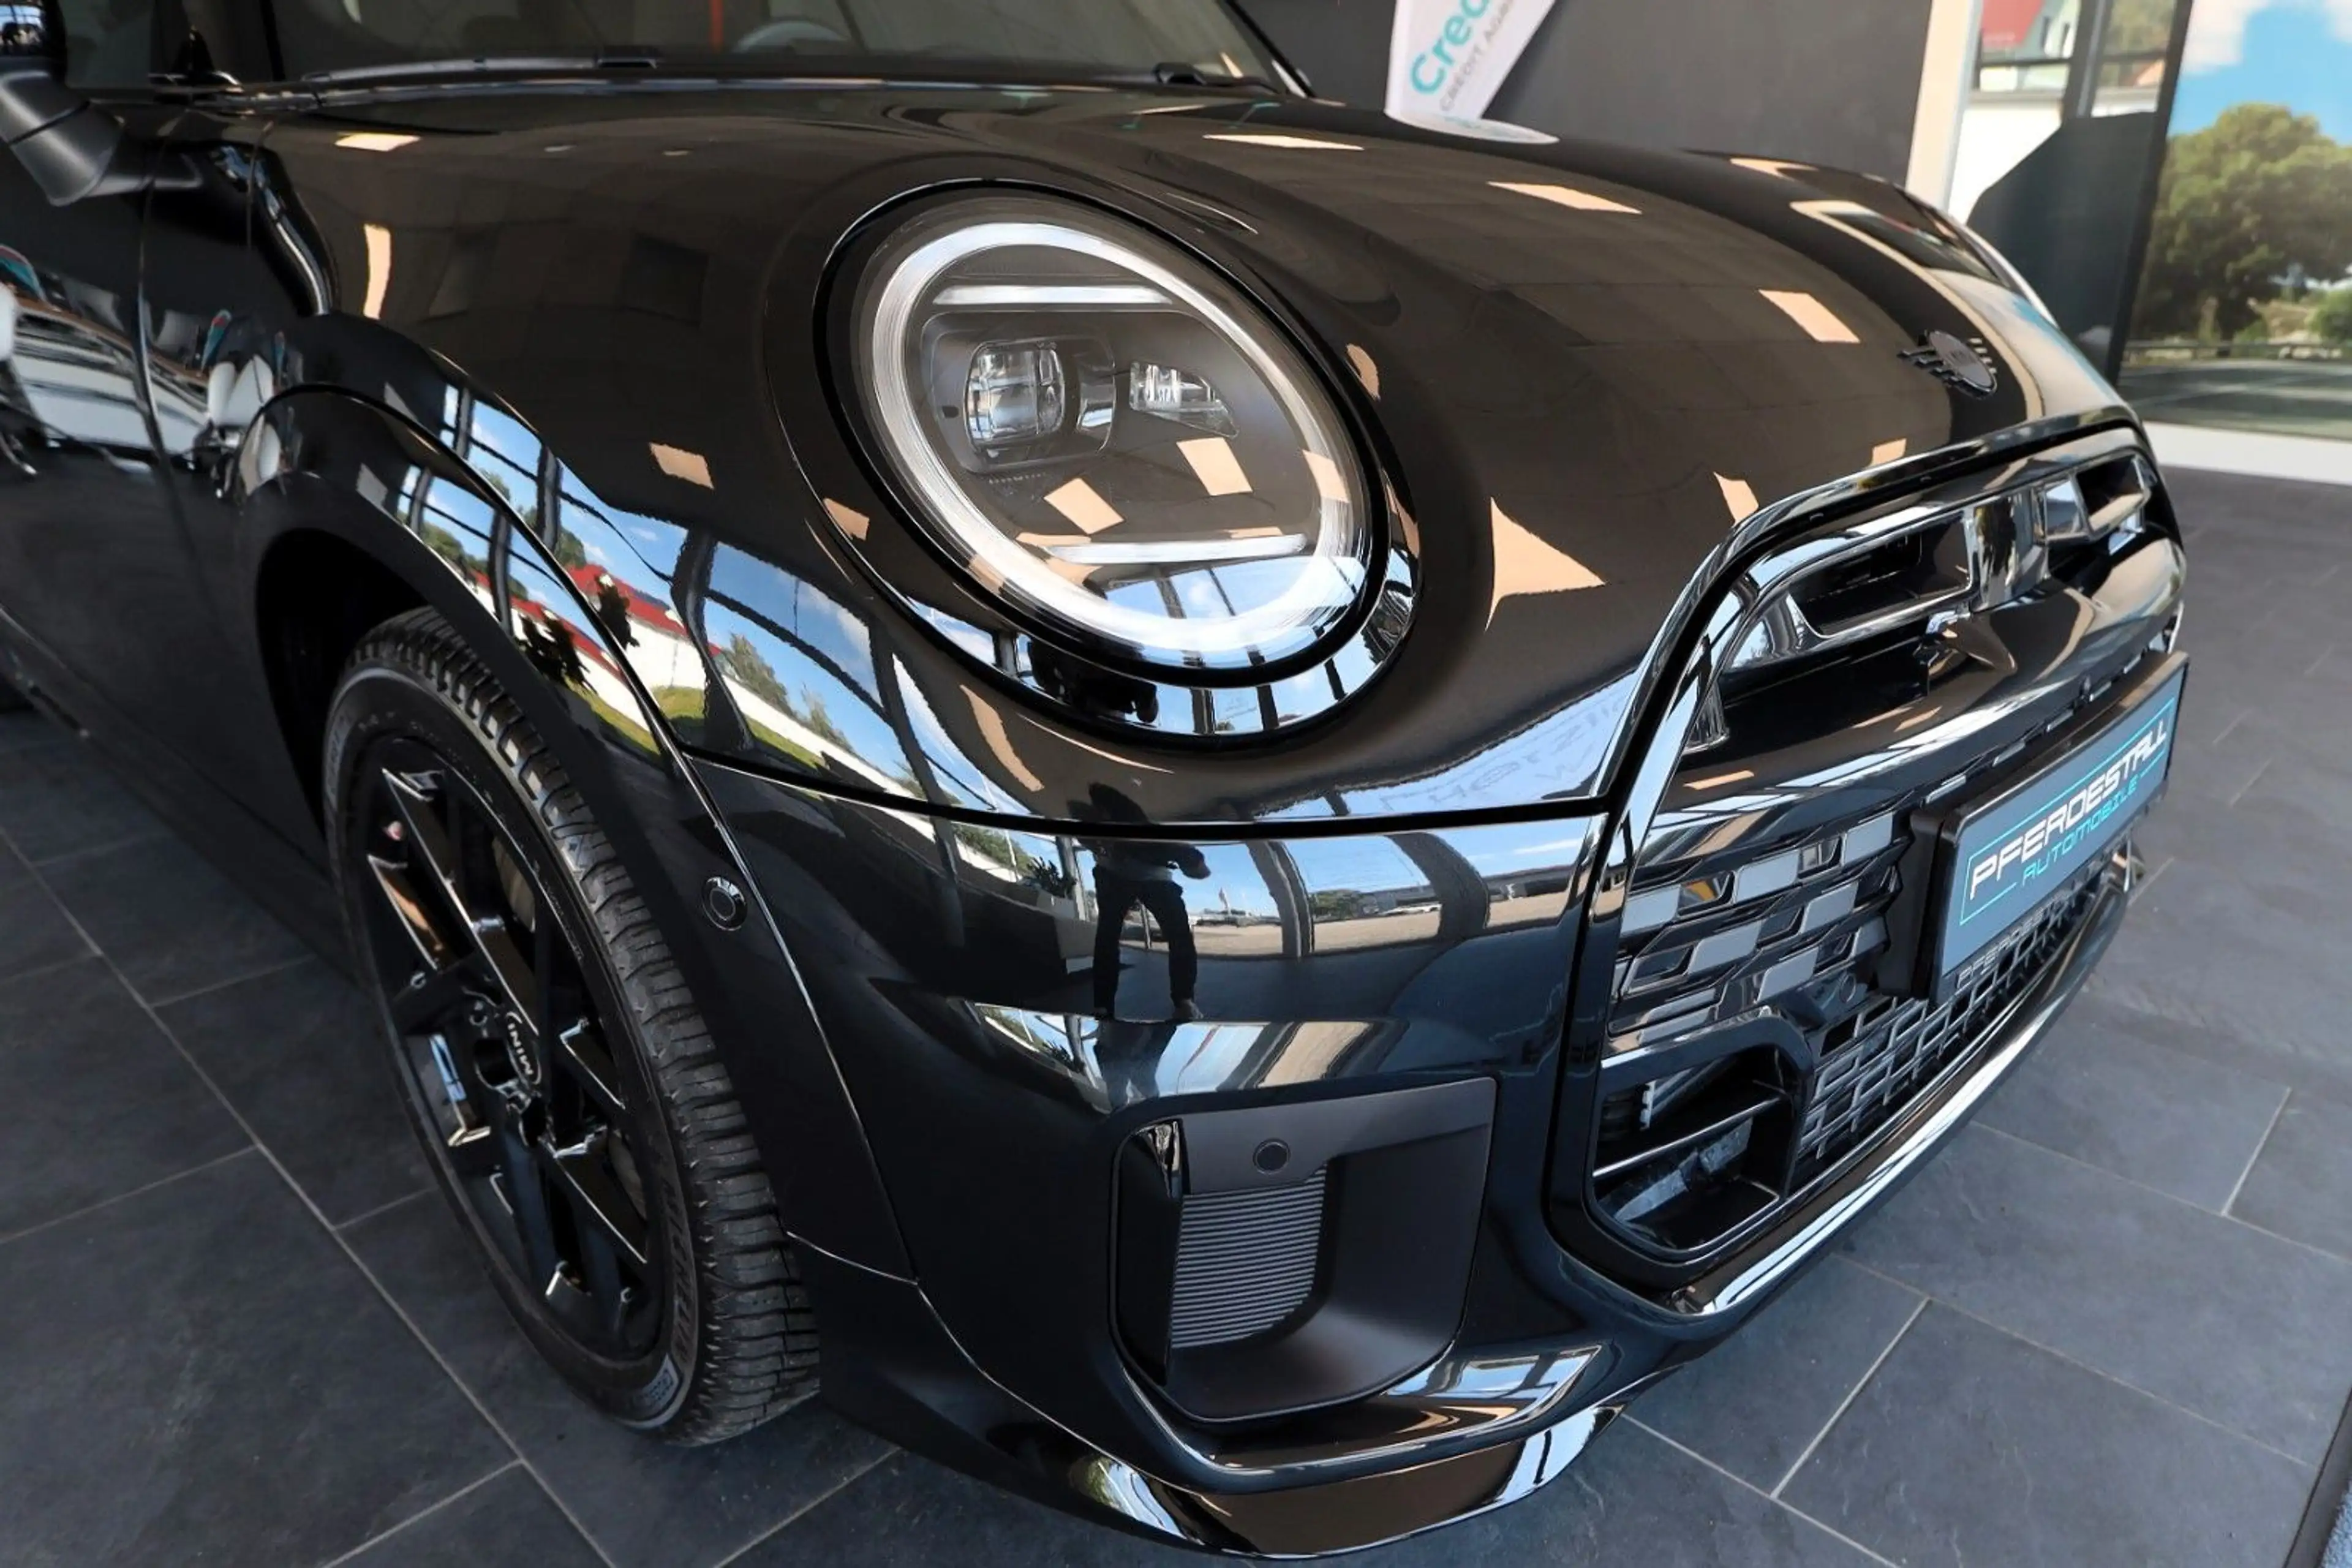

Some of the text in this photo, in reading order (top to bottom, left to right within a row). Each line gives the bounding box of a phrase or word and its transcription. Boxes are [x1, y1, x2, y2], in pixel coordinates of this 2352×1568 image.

[1970, 720, 2167, 899] PFERDESTALL
[2022, 774, 2138, 886] AUTOMOBILE
[507, 1022, 533, 1075] MINI
